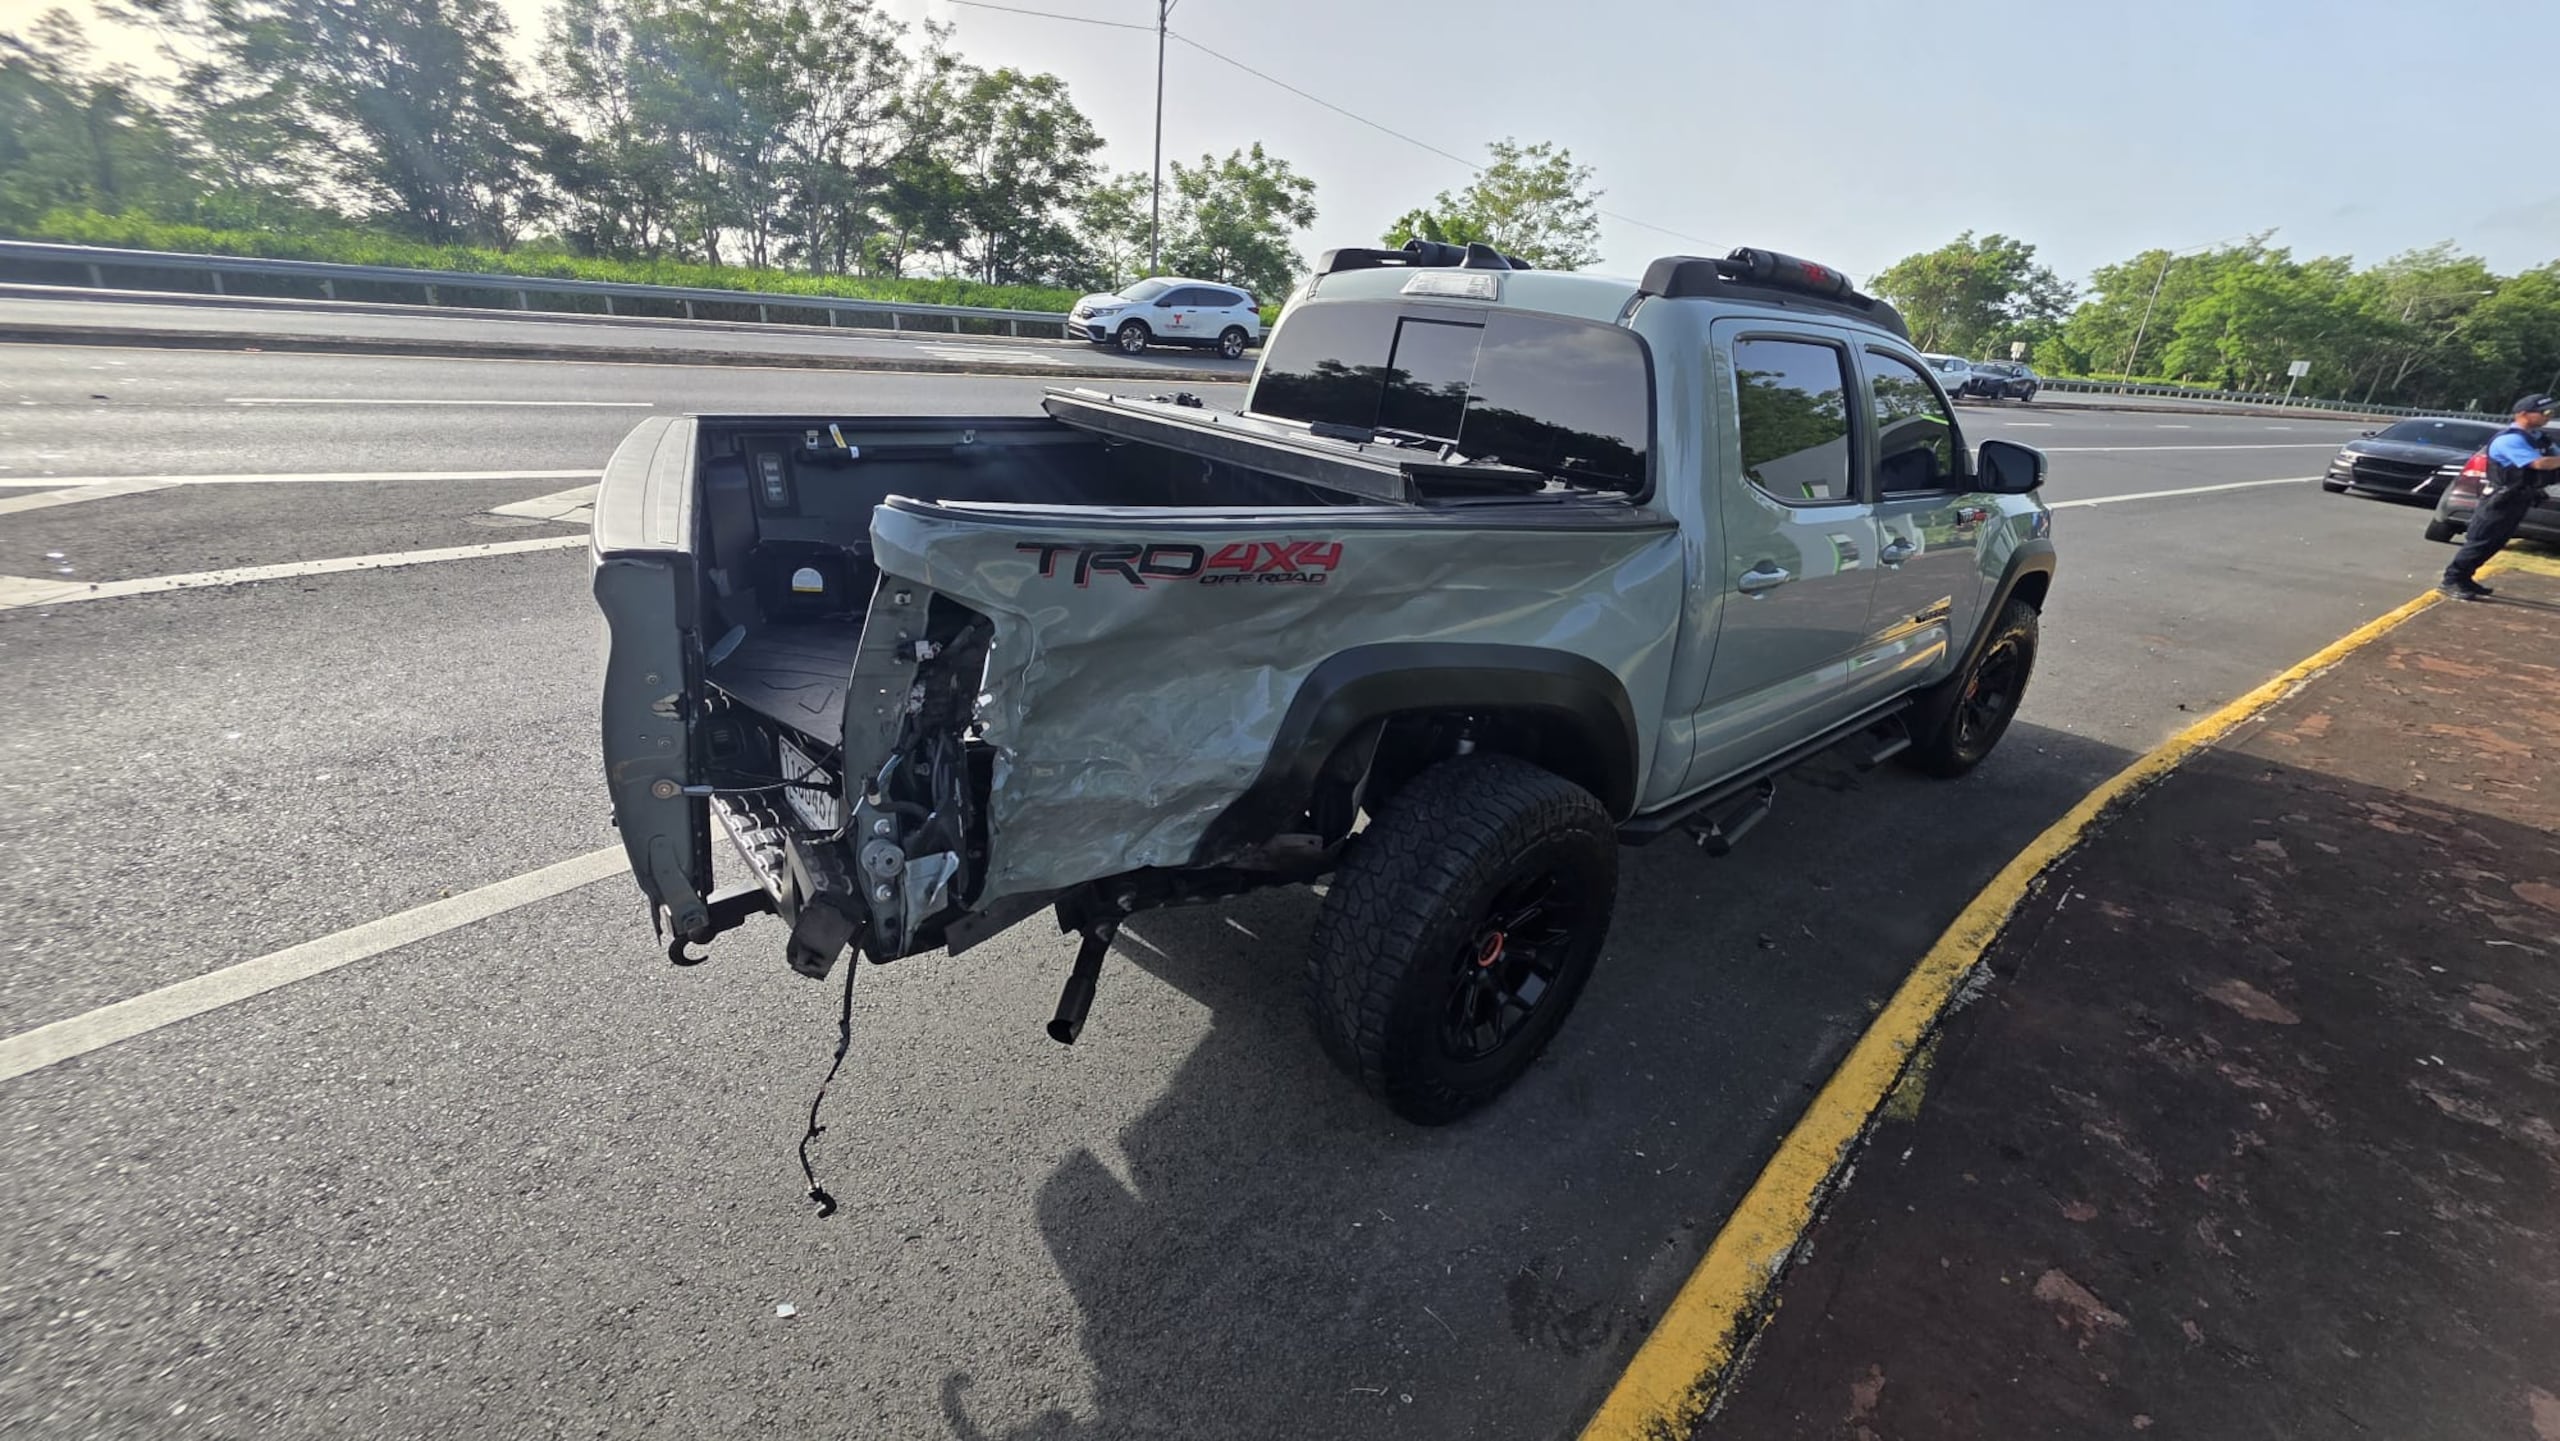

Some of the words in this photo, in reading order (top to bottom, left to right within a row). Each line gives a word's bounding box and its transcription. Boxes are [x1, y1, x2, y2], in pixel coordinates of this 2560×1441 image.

[1015, 541, 1206, 589] TRD
[1200, 573, 1253, 585] OFF
[1256, 572, 1328, 585] ROAD
